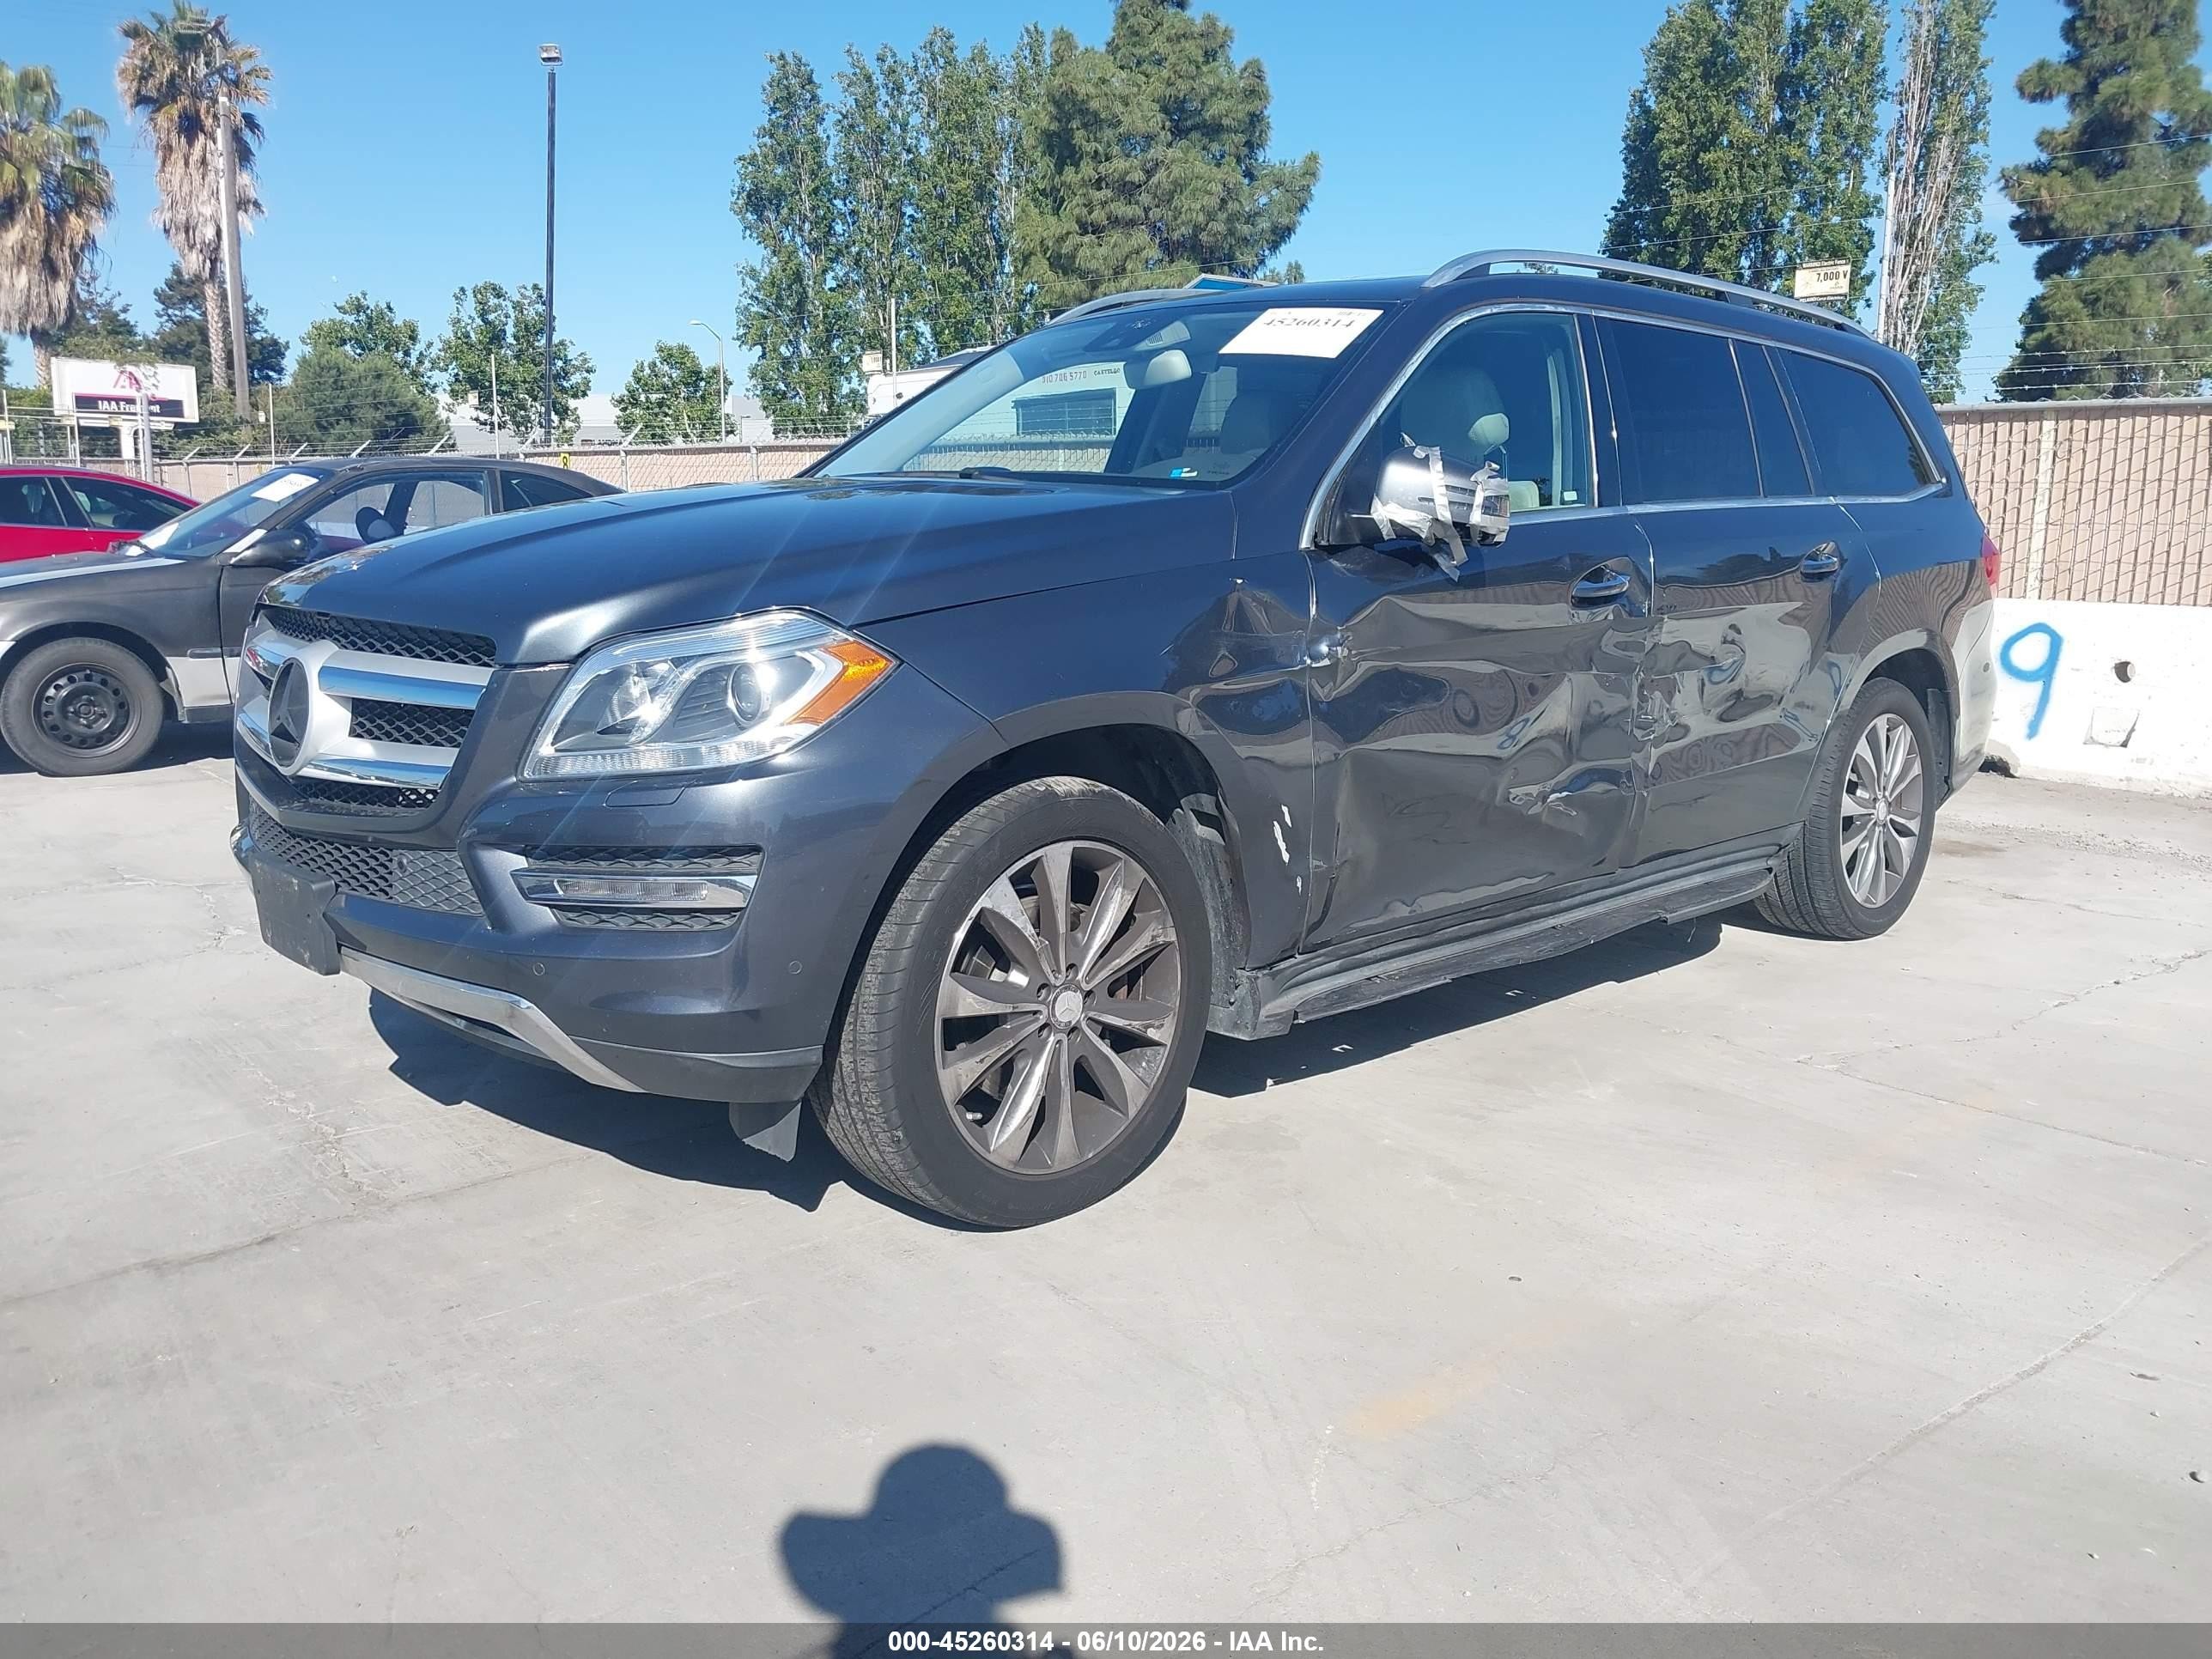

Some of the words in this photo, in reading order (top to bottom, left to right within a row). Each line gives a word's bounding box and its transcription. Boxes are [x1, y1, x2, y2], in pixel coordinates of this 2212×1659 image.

[1817, 271, 1840, 283] 7,000
[1843, 270, 1849, 279] V
[1264, 318, 1355, 327] 45260314
[1069, 370, 1087, 380] 5770
[98, 400, 118, 411] IAA
[2000, 622, 2064, 740] 9
